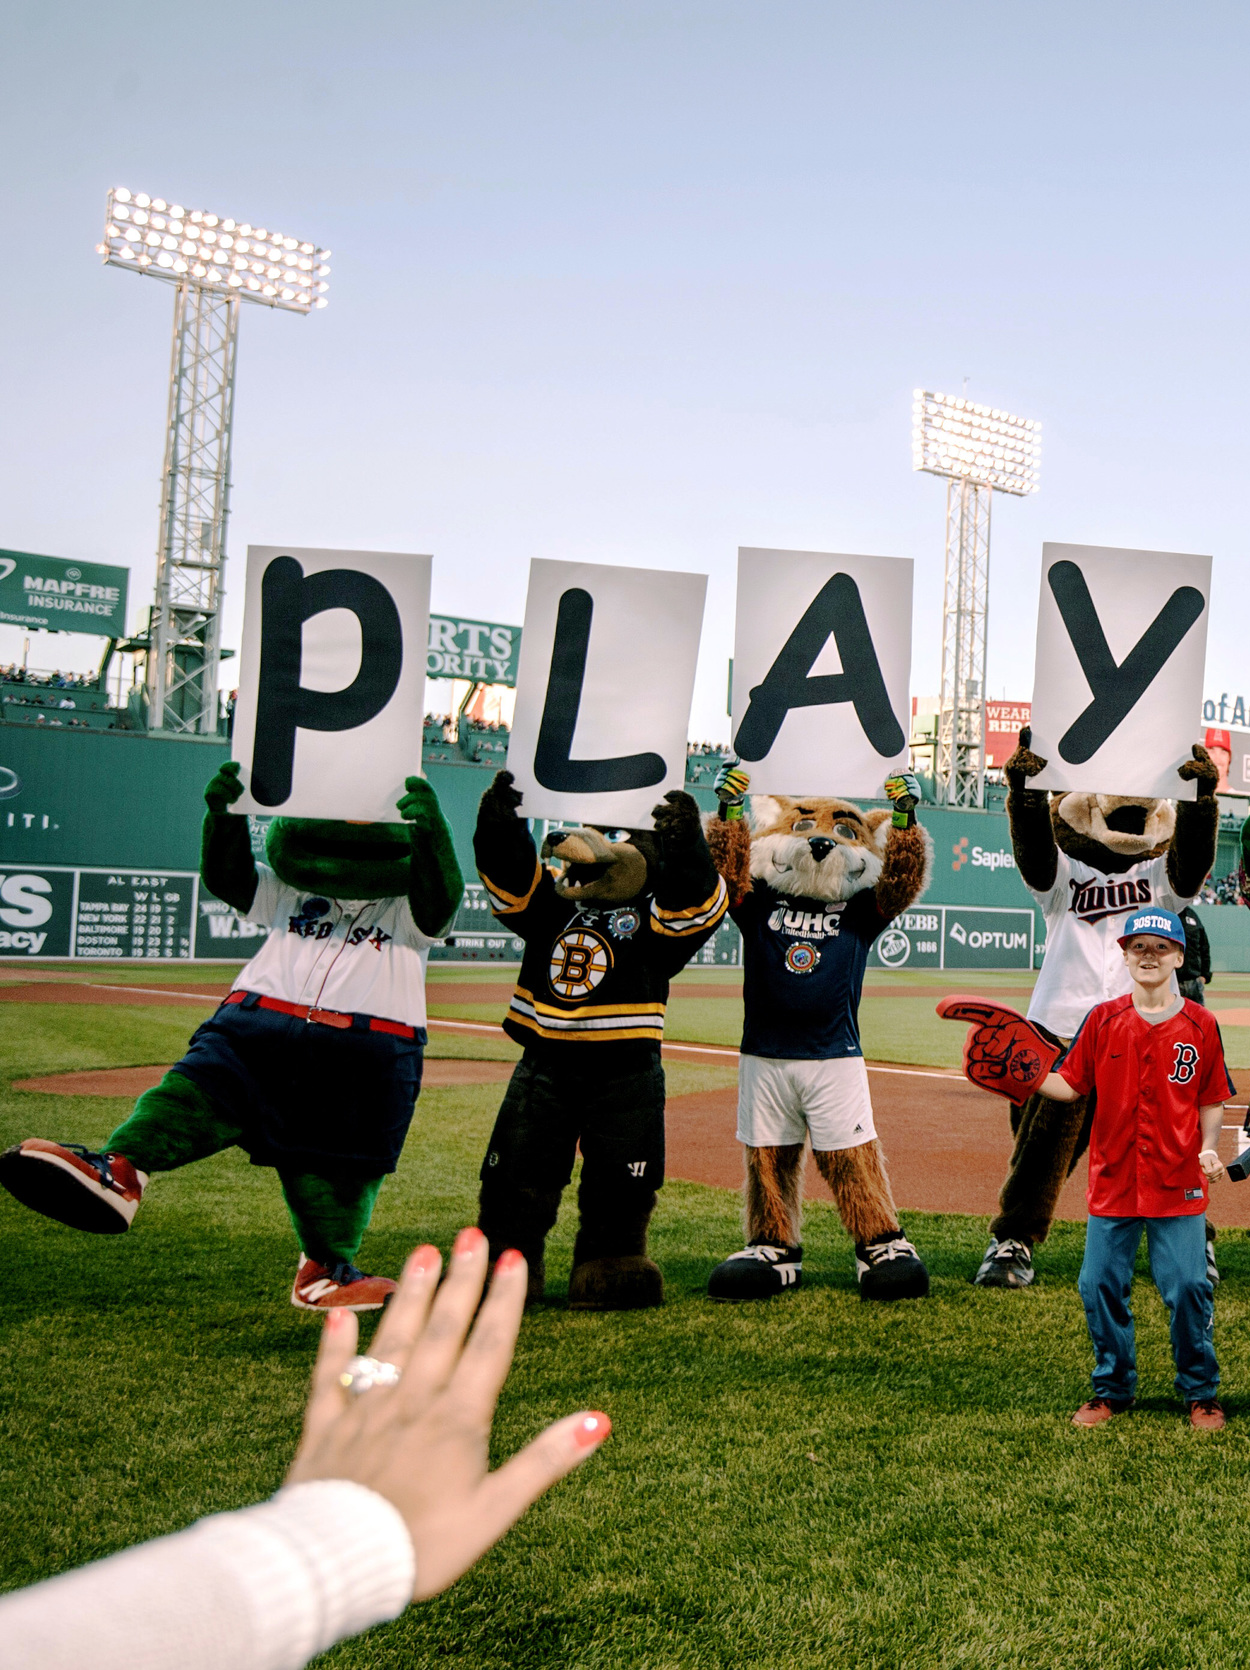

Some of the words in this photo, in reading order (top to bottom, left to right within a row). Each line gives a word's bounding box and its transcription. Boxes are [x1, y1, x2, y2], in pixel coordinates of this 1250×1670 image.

[23, 575, 120, 601] MAPFRE
[28, 594, 113, 617] INSURANCE
[733, 572, 906, 762] A
[1047, 560, 1206, 765] Y
[534, 587, 667, 793] L
[986, 706, 1030, 720] WEAR
[1203, 692, 1228, 723] of
[107, 875, 126, 887] AL
[131, 876, 168, 888] EAST
[133, 891, 149, 902] W
[151, 892, 161, 902] L
[163, 892, 180, 903] GB
[1068, 877, 1152, 915] Twins
[80, 901, 110, 912] TAMPA
[110, 902, 130, 913] BAY
[133, 903, 148, 914] 24
[149, 903, 162, 914] 19
[79, 912, 100, 923] NEW
[102, 913, 128, 924] YORK
[133, 914, 147, 925] 22
[149, 914, 161, 925] 21
[166, 914, 175, 926] 2
[288, 915, 334, 940] RED
[783, 909, 841, 932] UHC
[889, 914, 938, 932] WEBB
[1132, 915, 1172, 932] BOSTON
[77, 924, 129, 935] BALTIMORE
[147, 925, 162, 936] 20
[166, 925, 174, 937] 3
[77, 936, 118, 946] BOSTON
[147, 937, 161, 947] 23
[165, 937, 174, 948] 4
[455, 938, 485, 948] STRIKE
[486, 938, 507, 948] OUT
[916, 941, 938, 953] 1866
[968, 931, 1027, 949] OPTUM
[77, 946, 124, 957] TORONTO
[146, 947, 160, 958] 25
[557, 943, 594, 986] B
[1167, 1042, 1200, 1084] B
